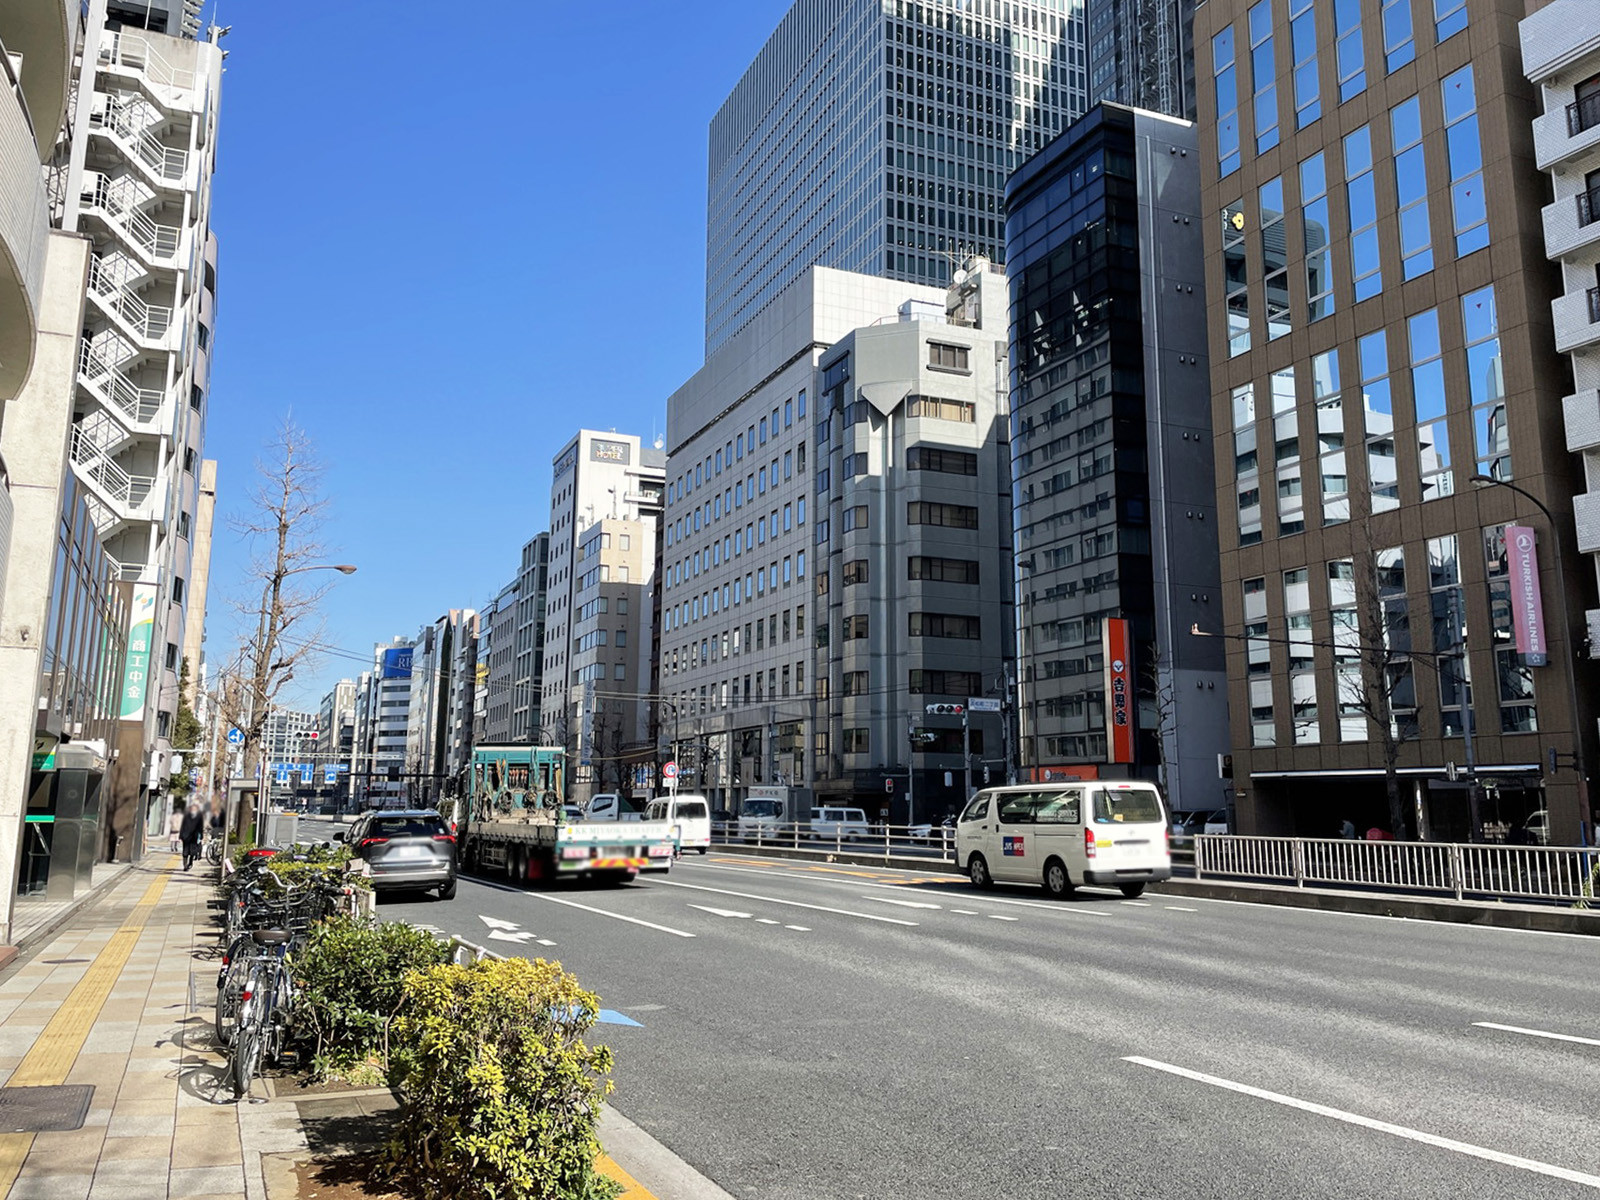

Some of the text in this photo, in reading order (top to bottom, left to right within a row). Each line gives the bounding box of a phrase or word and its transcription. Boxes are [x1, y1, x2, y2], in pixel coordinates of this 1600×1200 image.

[595, 450, 623, 461] HOTEL
[1521, 553, 1540, 652] TURKISH AIRLINES
[127, 639, 146, 699] 商工中金
